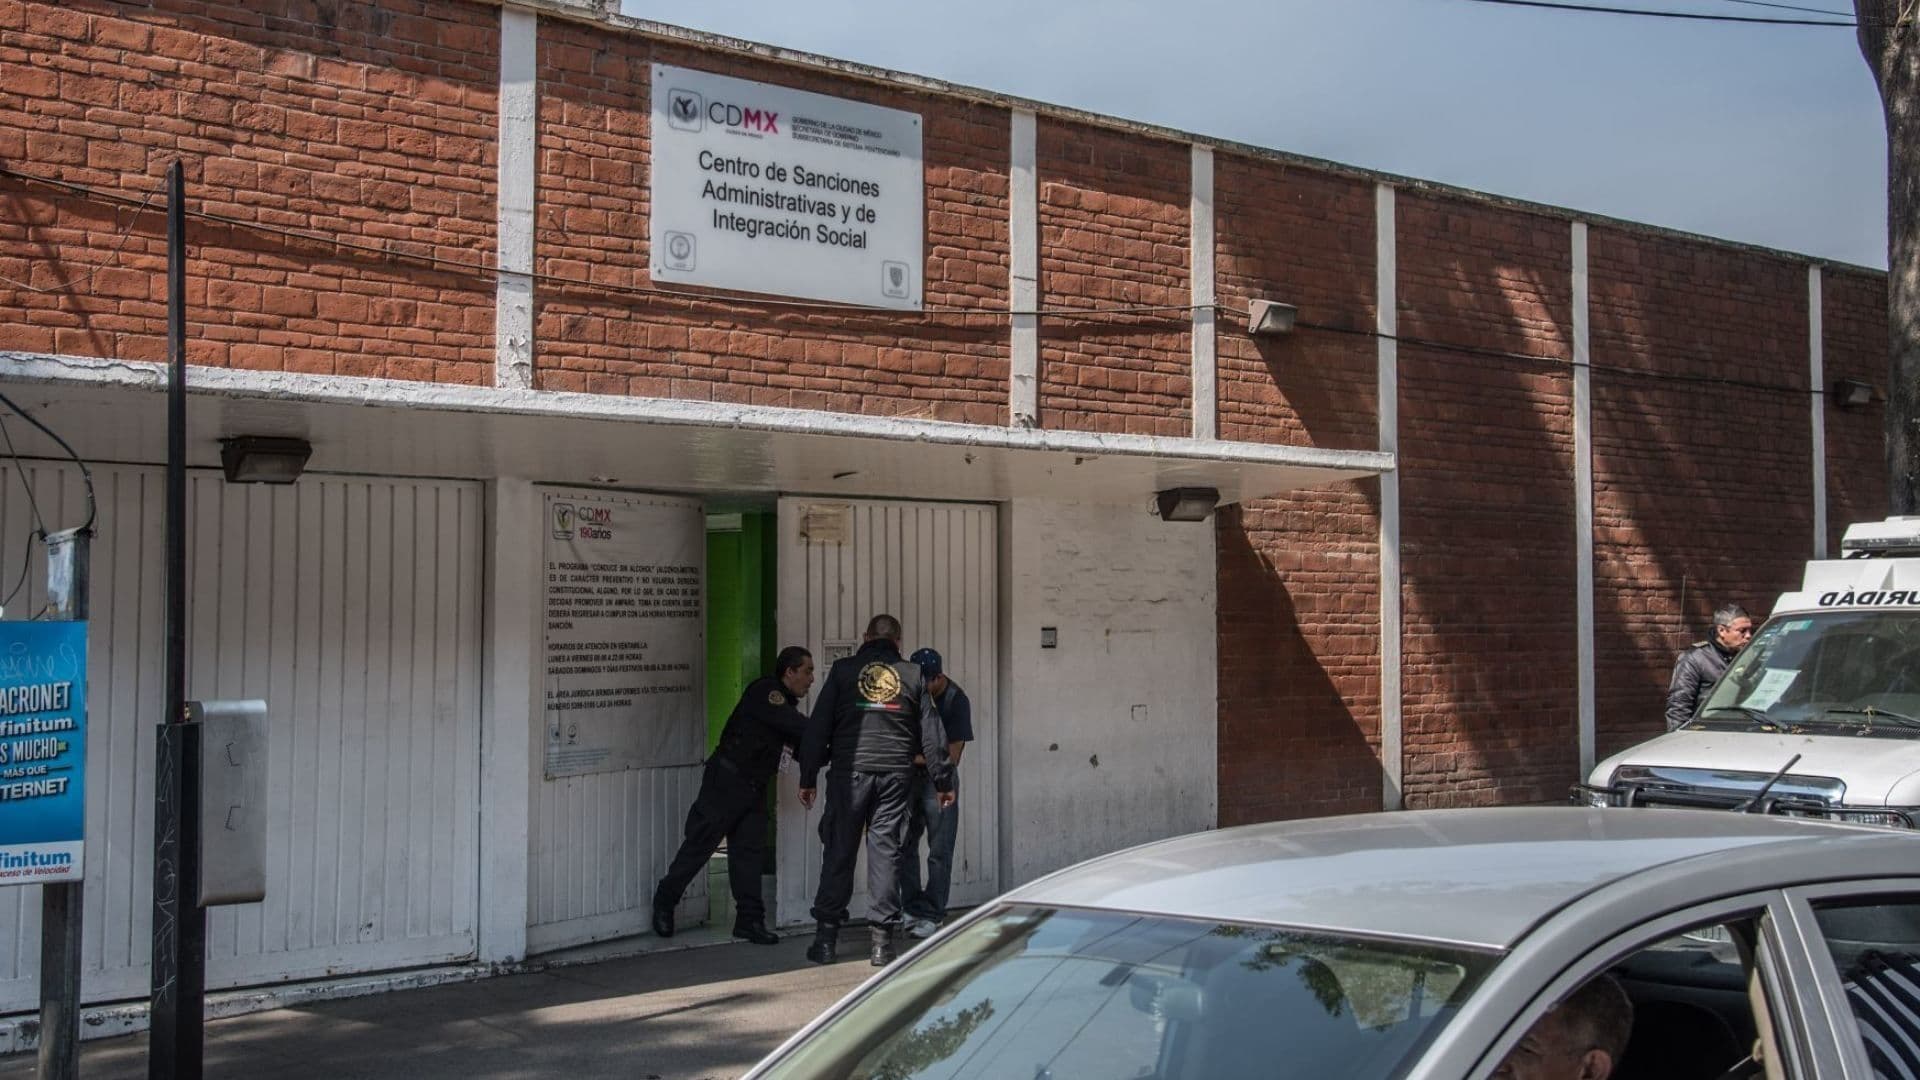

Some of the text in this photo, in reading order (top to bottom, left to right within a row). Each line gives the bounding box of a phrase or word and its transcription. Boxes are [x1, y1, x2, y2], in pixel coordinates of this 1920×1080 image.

[708, 101, 778, 134] CDMX
[699, 150, 880, 198] Centro de Sanciones
[702, 180, 876, 225] Administrativas y de
[713, 209, 867, 250] Integración Social
[579, 506, 612, 522] CDMX
[642, 576, 650, 584] NO
[0, 682, 71, 714] ACRONET
[13, 737, 58, 762] MUCHO
[27, 765, 47, 776] QUE
[0, 776, 68, 800] TERNET
[23, 867, 32, 876] de
[34, 865, 71, 876] Velocidad
